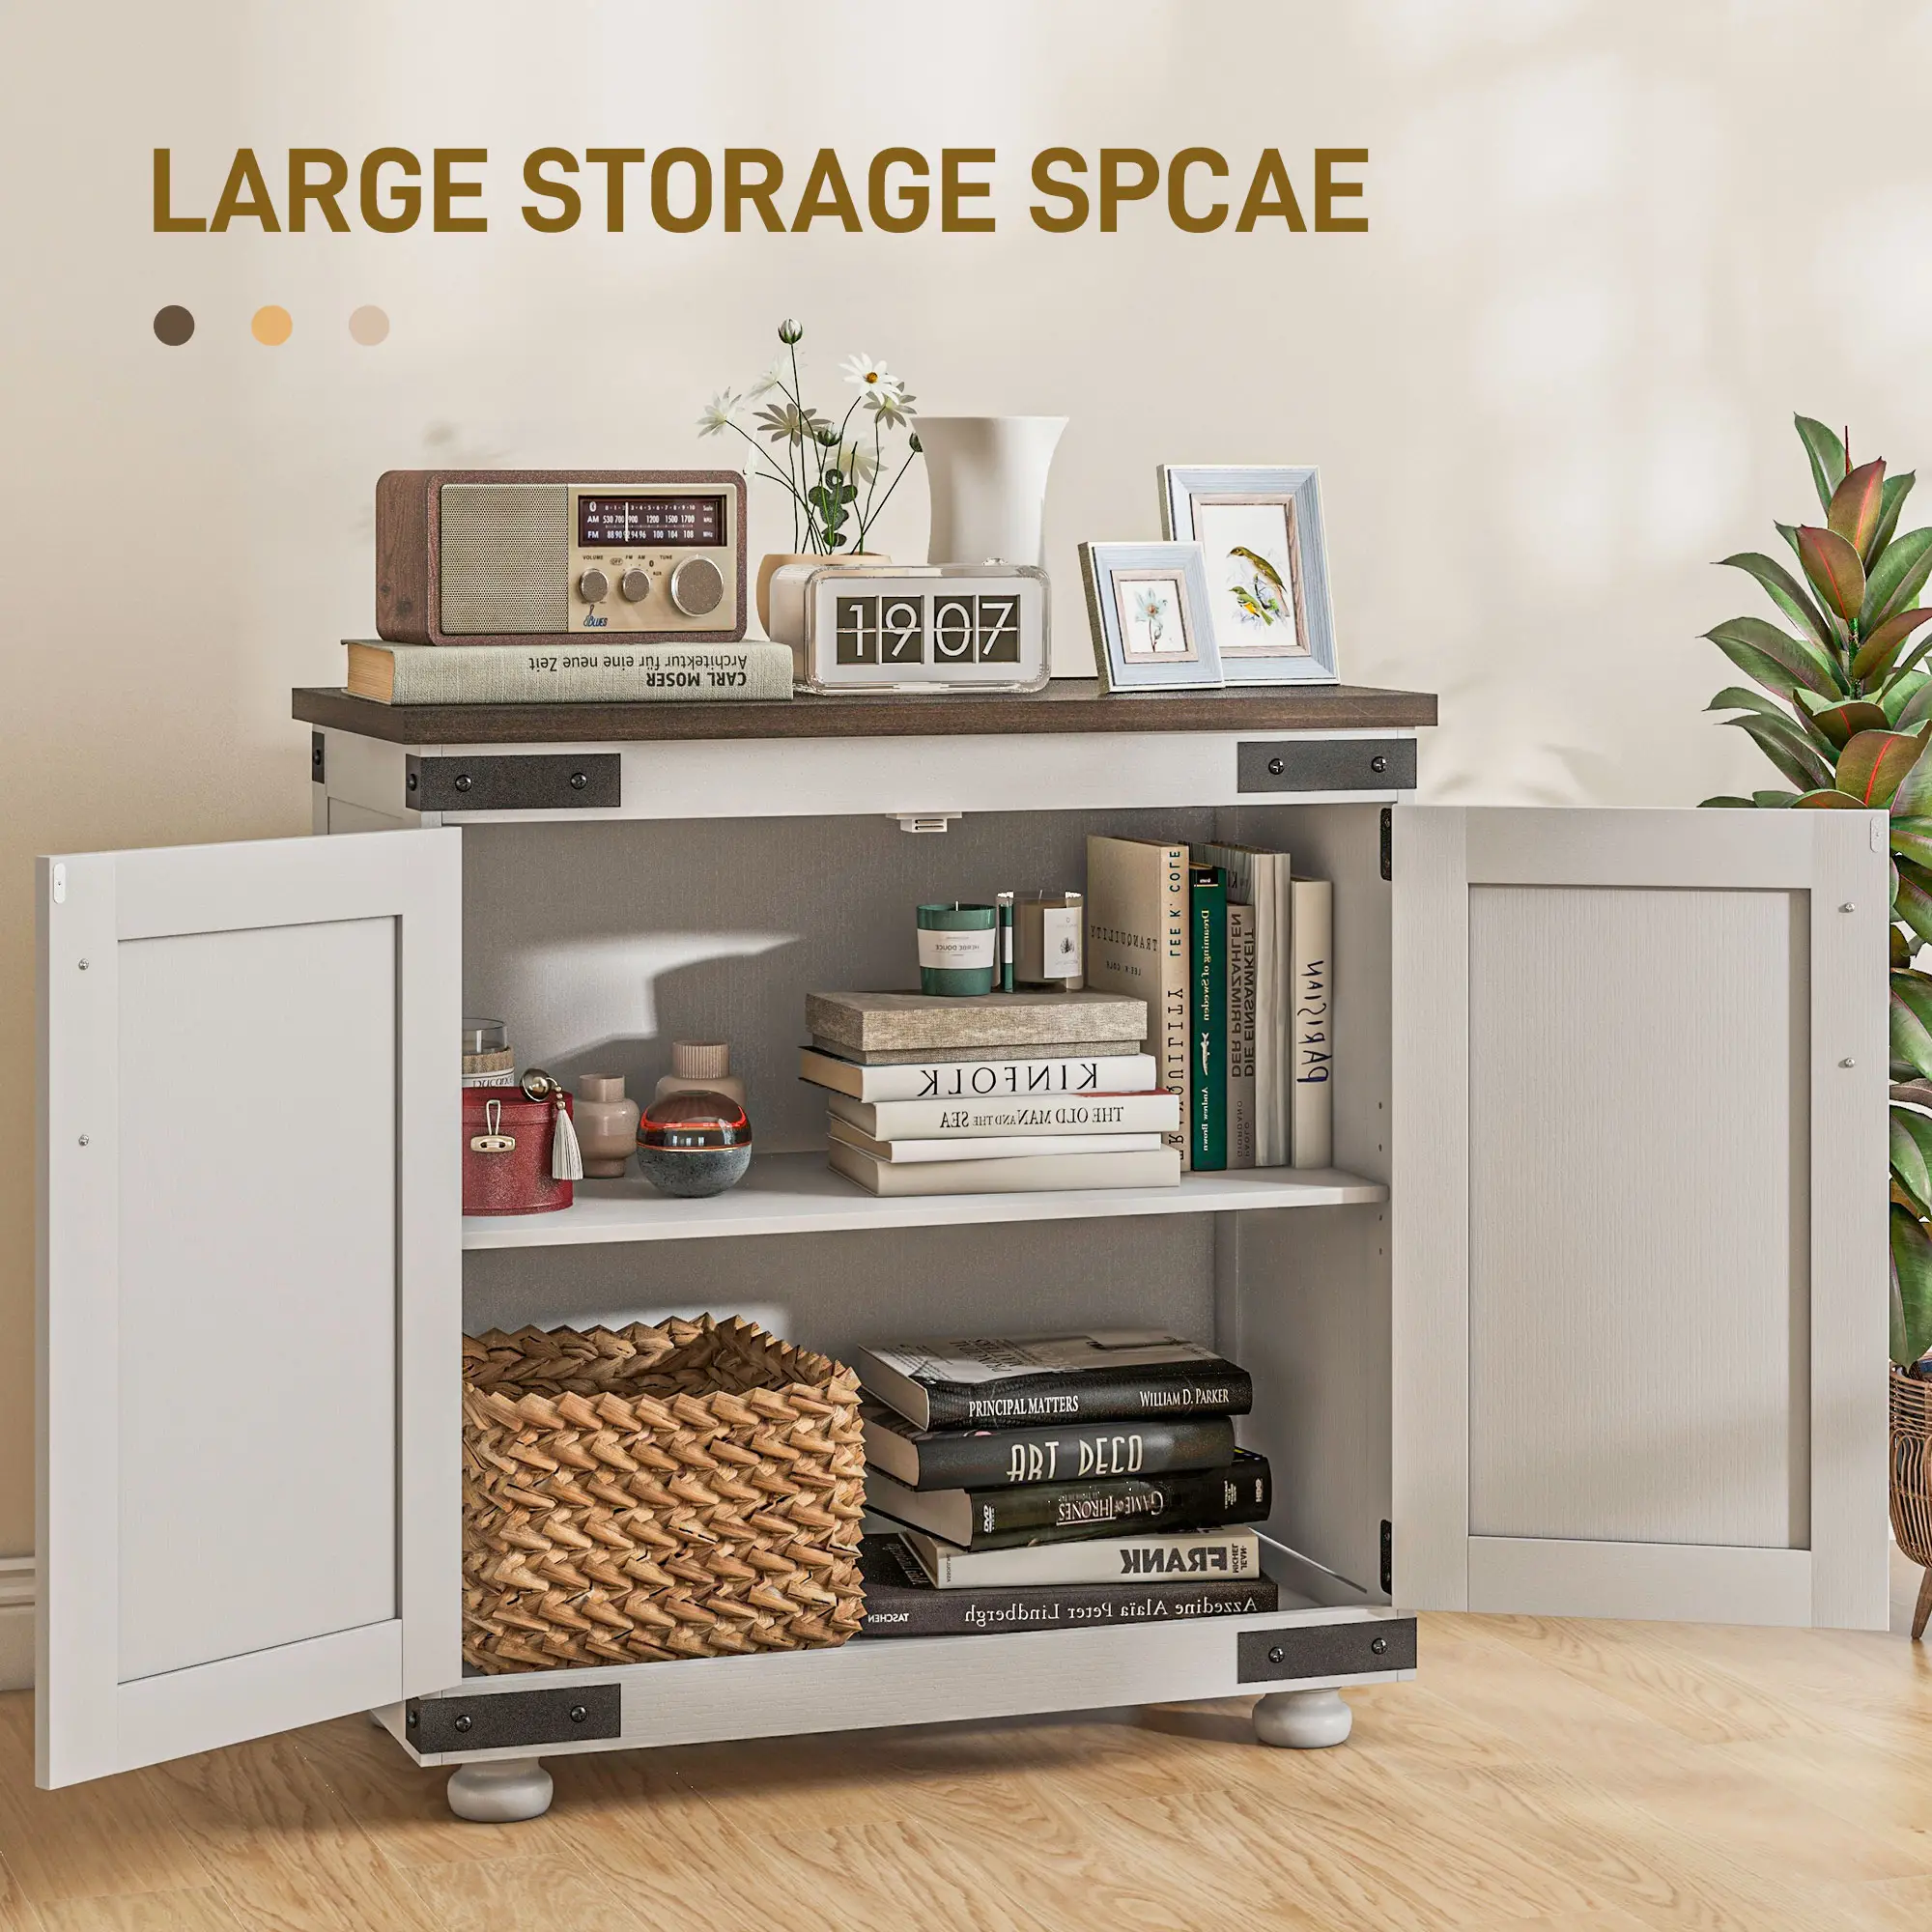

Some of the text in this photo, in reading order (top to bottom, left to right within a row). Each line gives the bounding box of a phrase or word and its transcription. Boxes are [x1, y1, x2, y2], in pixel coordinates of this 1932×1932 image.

[528, 655, 748, 671] Architektur für eine neue Zeit
[646, 672, 747, 687] CARL MOSER
[969, 1396, 1079, 1417] PRINCIPAL MATTERS
[1140, 1388, 1229, 1406] WILLIAM D. PARKER
[1007, 1435, 1143, 1482] ART DECO
[1056, 1496, 1117, 1525] THRONES
[1124, 1491, 1164, 1516] GAME
